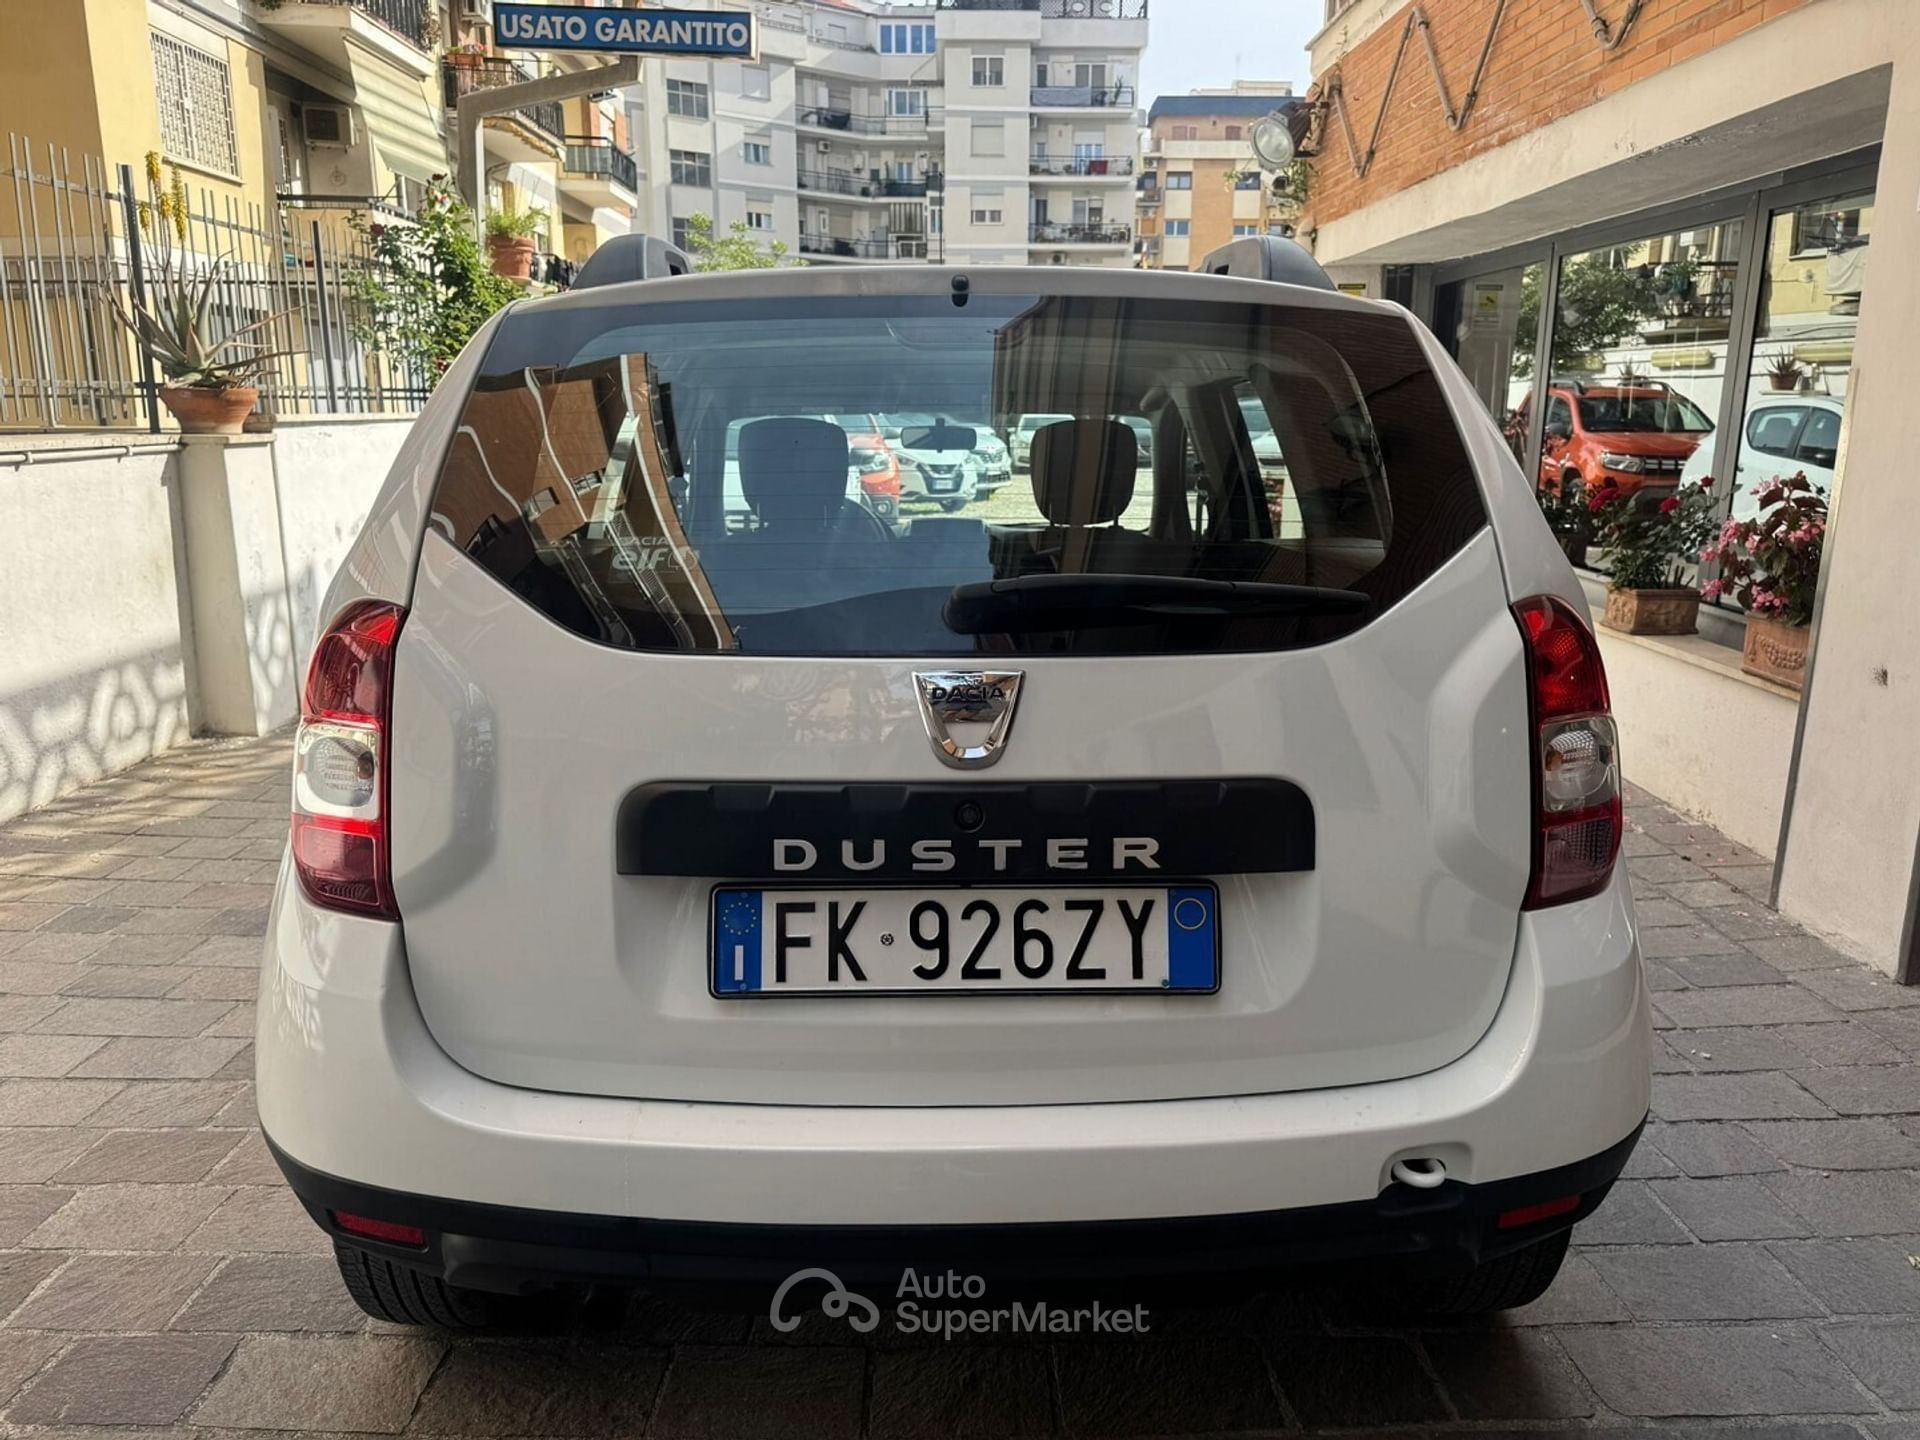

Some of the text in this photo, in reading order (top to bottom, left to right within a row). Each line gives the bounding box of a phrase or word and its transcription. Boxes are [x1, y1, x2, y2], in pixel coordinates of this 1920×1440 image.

[500, 14, 748, 48] USATO GARANTITO
[932, 686, 1004, 700] DACIA
[773, 837, 1160, 871] DUSTER
